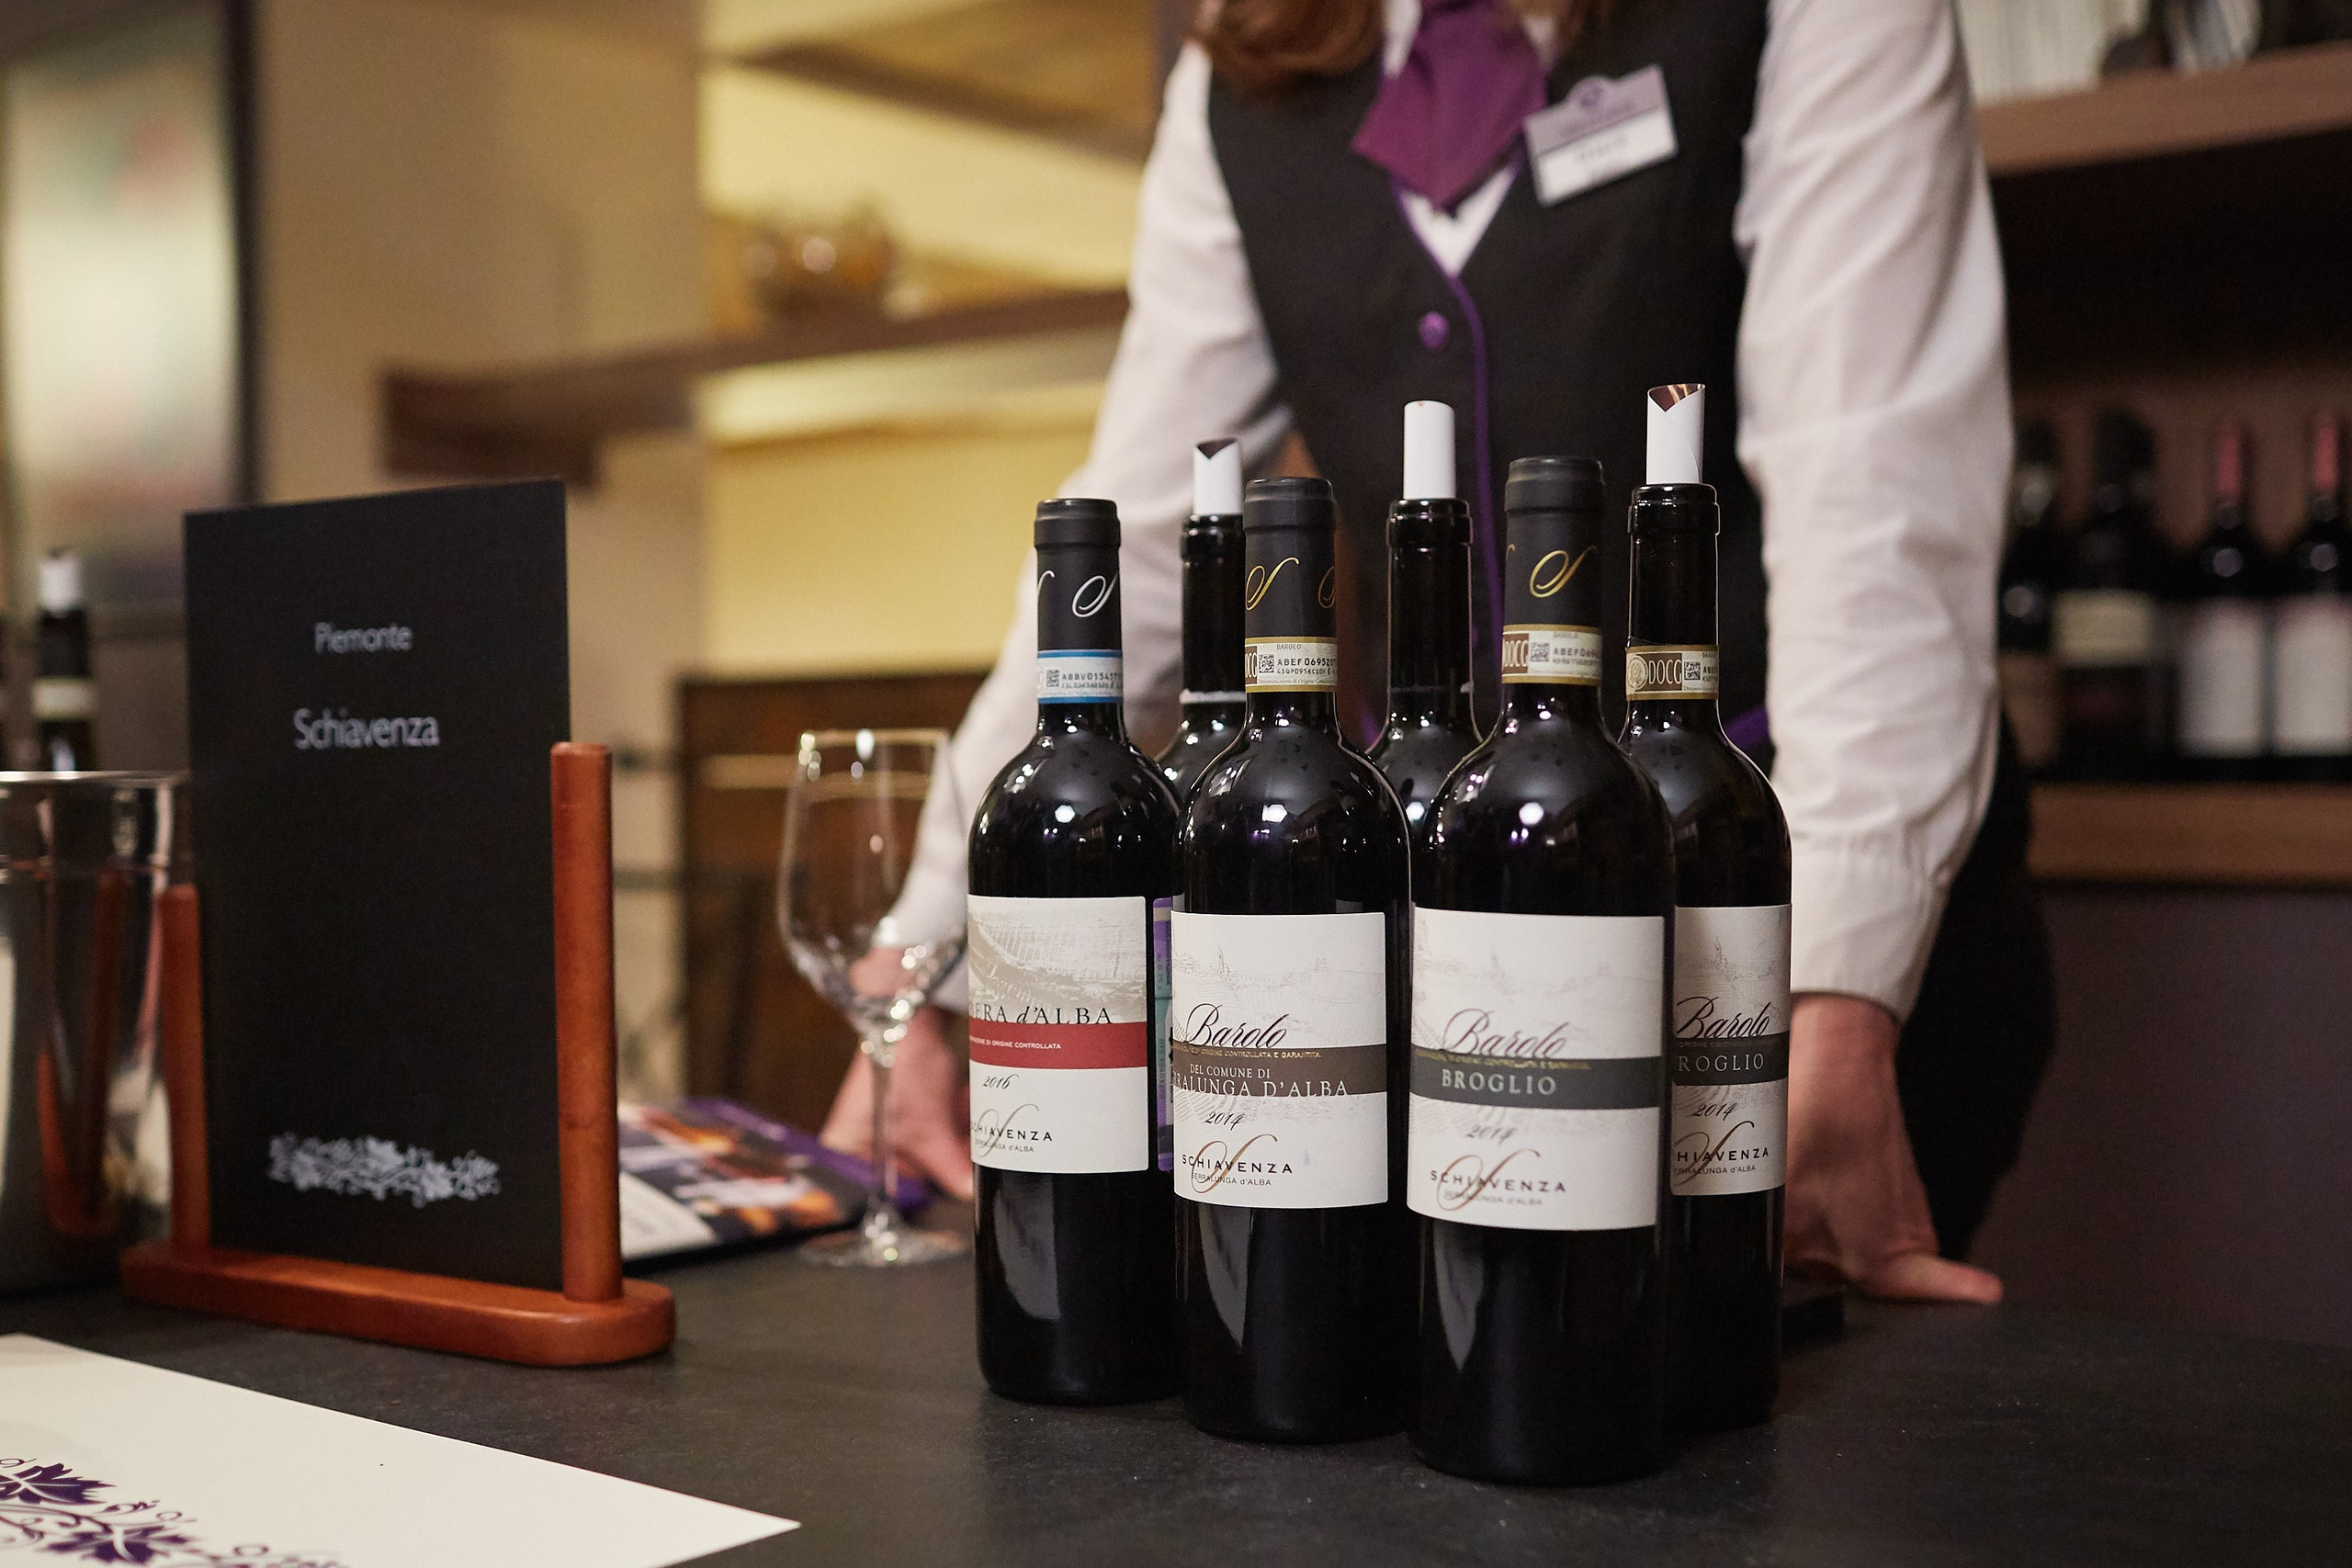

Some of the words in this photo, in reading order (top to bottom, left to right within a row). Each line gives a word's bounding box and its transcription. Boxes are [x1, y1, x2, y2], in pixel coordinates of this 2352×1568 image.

[314, 622, 413, 654] Piemonte
[1648, 660, 1682, 684] DOCG
[293, 708, 440, 750] Schiavenza
[1677, 997, 1771, 1039] Barolo
[1186, 1003, 1290, 1055] Barolo
[1442, 1009, 1569, 1056] Barolo
[1014, 1042, 1061, 1050] CONTROLLATA
[1225, 1050, 1272, 1059] CONTROLLATA
[1190, 1063, 1204, 1075] DEL
[1206, 1066, 1253, 1078] COMUNE
[1258, 1068, 1271, 1079] DI
[1679, 1054, 1763, 1072] ROGLIO
[983, 1074, 1019, 1090] 2016
[1263, 1080, 1349, 1098] D'ALBA
[1442, 1068, 1556, 1096] BROGLIO
[1204, 1111, 1245, 1131] 2014
[1692, 1103, 1736, 1122] 2014
[1466, 1123, 1514, 1145] 2014
[1182, 1154, 1293, 1174] SCHIAVENZA
[1677, 1147, 1769, 1162] HIAVENZA
[1193, 1173, 1238, 1185] SERRALUNGA
[1430, 1170, 1566, 1192] SCHIAVENZA
